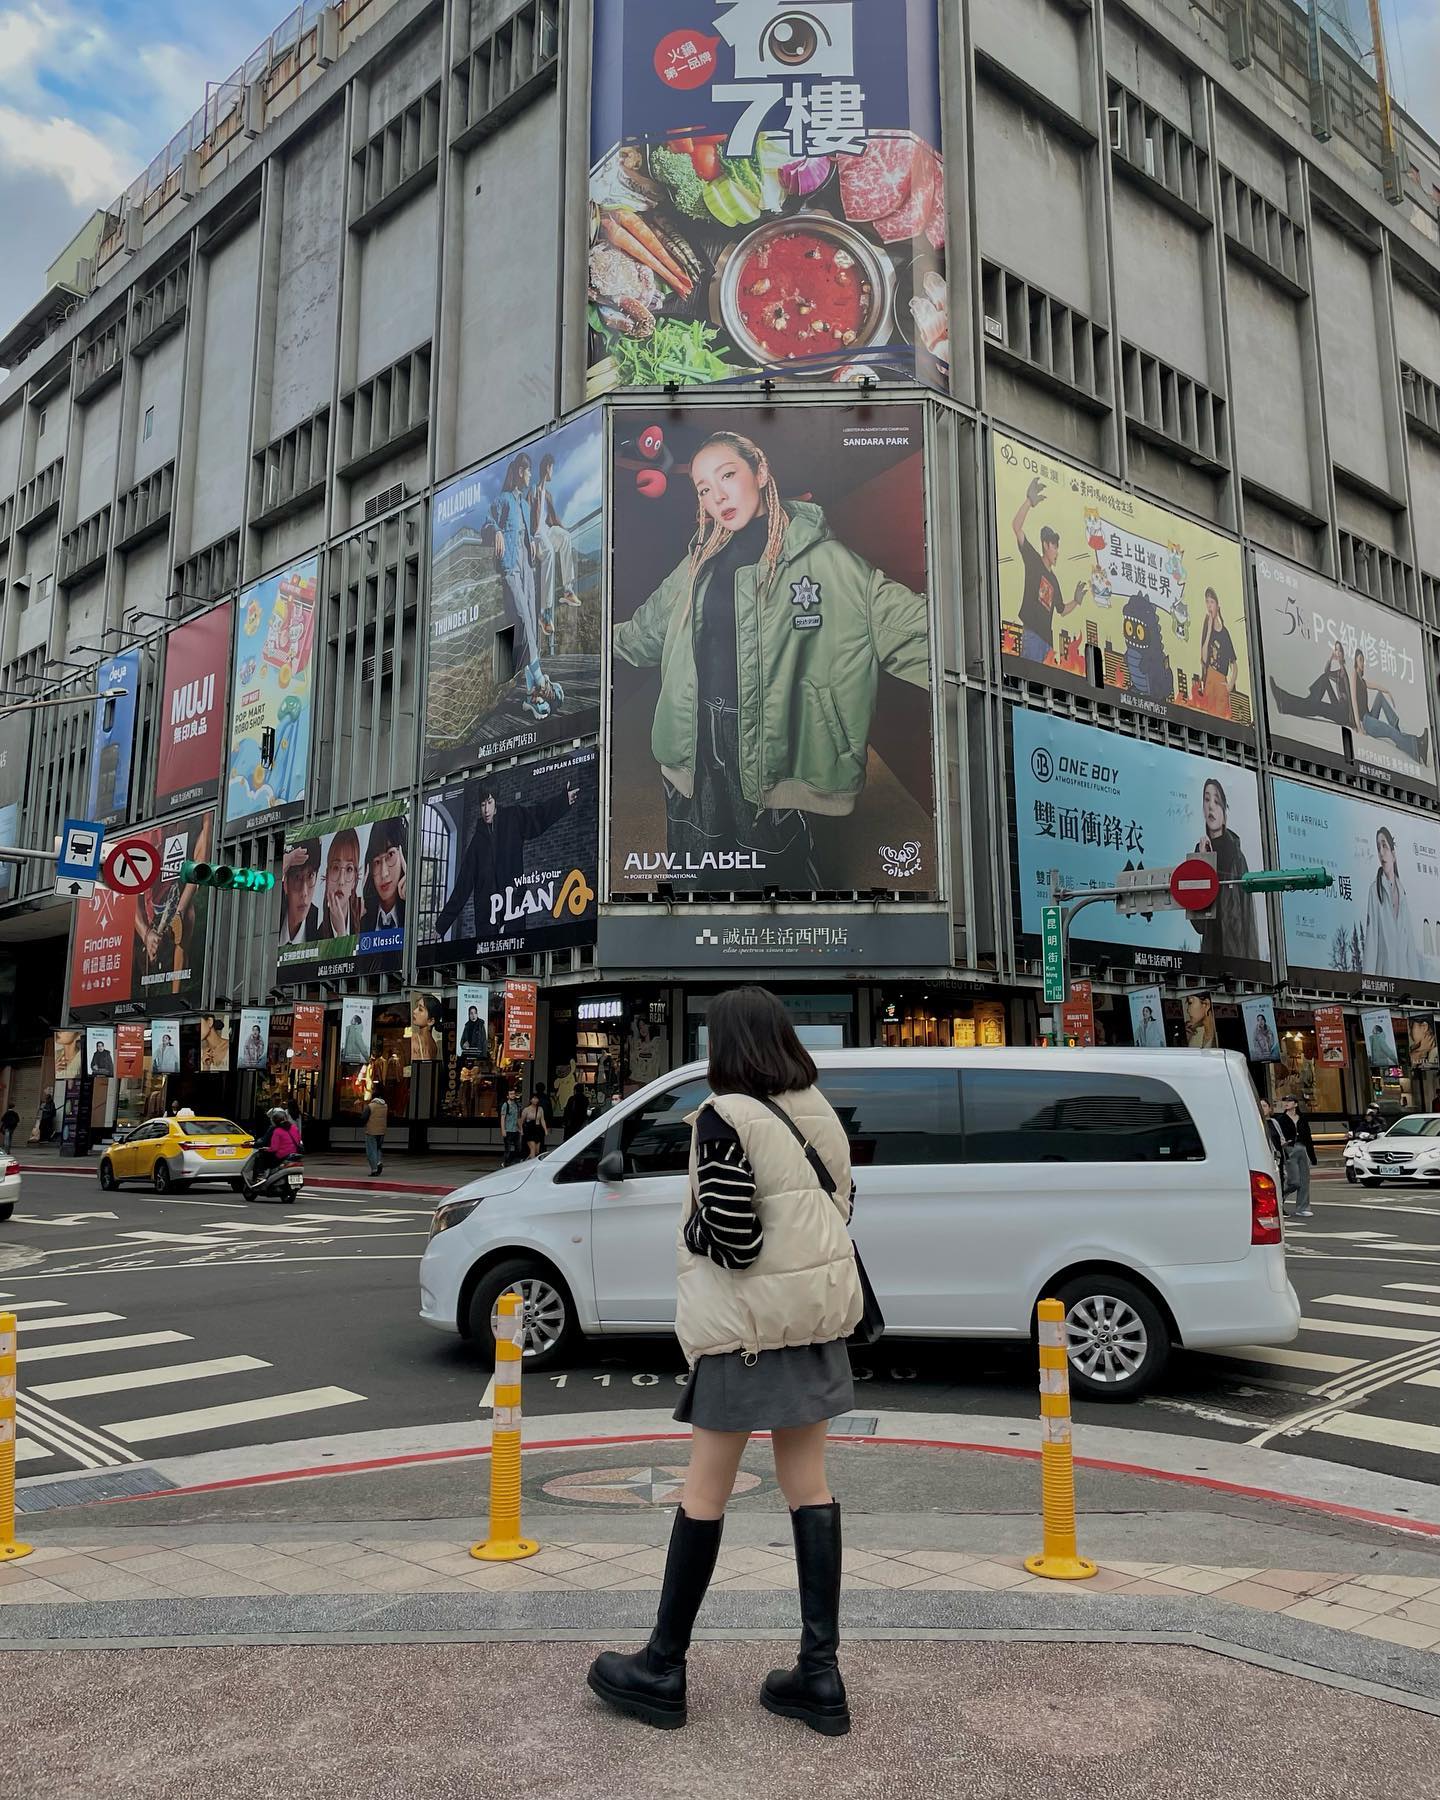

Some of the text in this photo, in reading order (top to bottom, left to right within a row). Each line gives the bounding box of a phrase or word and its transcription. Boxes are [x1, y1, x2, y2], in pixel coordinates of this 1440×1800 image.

[667, 40, 697, 64] 火鍋
[664, 51, 712, 80] 第一品牌
[711, 82, 866, 157] 7樓
[843, 437, 909, 447] SANDARA PARK
[437, 482, 480, 523] PALLADIUM
[1121, 562, 1172, 598] 環遊世界
[435, 609, 467, 637] THUNDER
[470, 604, 479, 622] LO
[171, 673, 215, 726] MUJI
[234, 715, 264, 735] ROBO SHOP
[235, 704, 266, 724] POP MART
[173, 716, 207, 744] 無印良品
[533, 768, 546, 776] 2023
[1059, 756, 1119, 784] ONE BOY
[1033, 800, 1144, 854] 雙面衝鋒衣
[1286, 811, 1328, 829] NEW ARRIVALS
[514, 870, 561, 887] What's your
[489, 881, 554, 925] PLAN
[83, 935, 122, 953] Findnew
[722, 927, 848, 945] 誠品生活西門店
[1047, 919, 1058, 963] 昆明街
[578, 1001, 622, 1019] STAYREAL
[649, 1002, 665, 1014] STAY
